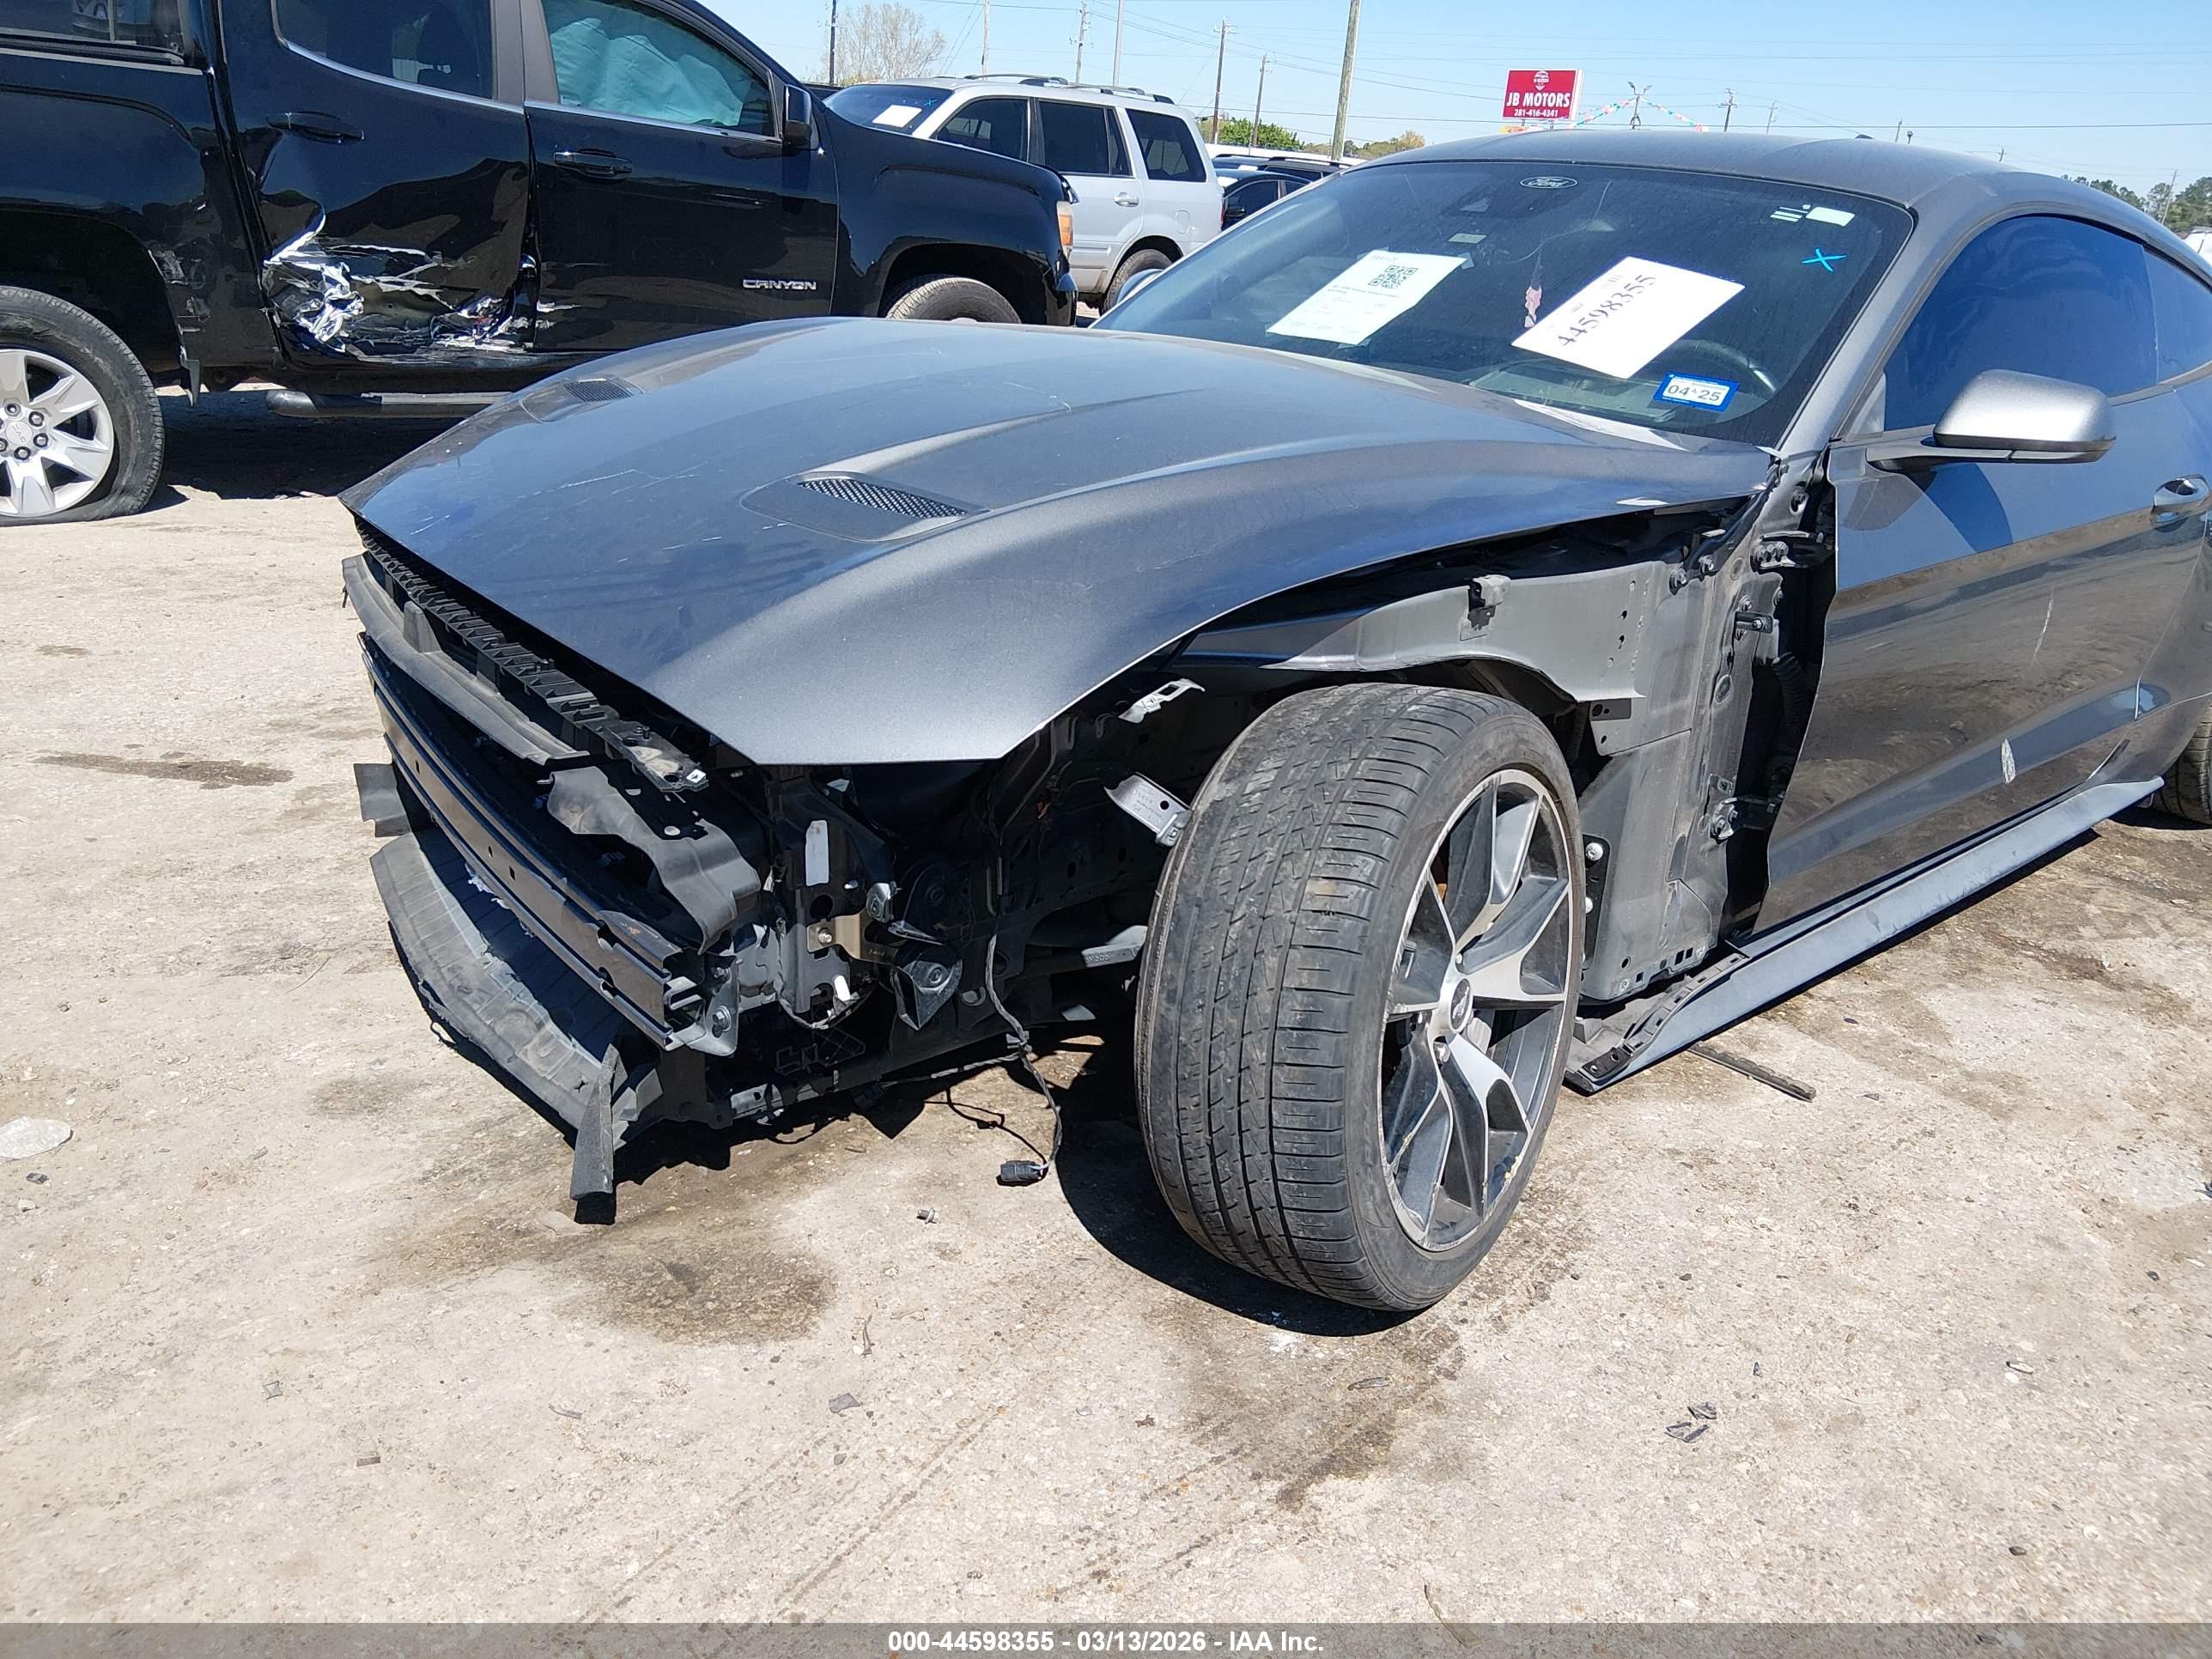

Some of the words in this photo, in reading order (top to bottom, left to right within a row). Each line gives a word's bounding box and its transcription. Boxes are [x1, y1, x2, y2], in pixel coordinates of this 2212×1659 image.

[1506, 92, 1520, 107] JB
[1522, 92, 1571, 107] MOTORS
[1514, 108, 1559, 117] 281-416-4341
[1528, 178, 1569, 187] Ford
[742, 278, 817, 290] CANYON
[1558, 274, 1656, 346] 44598355
